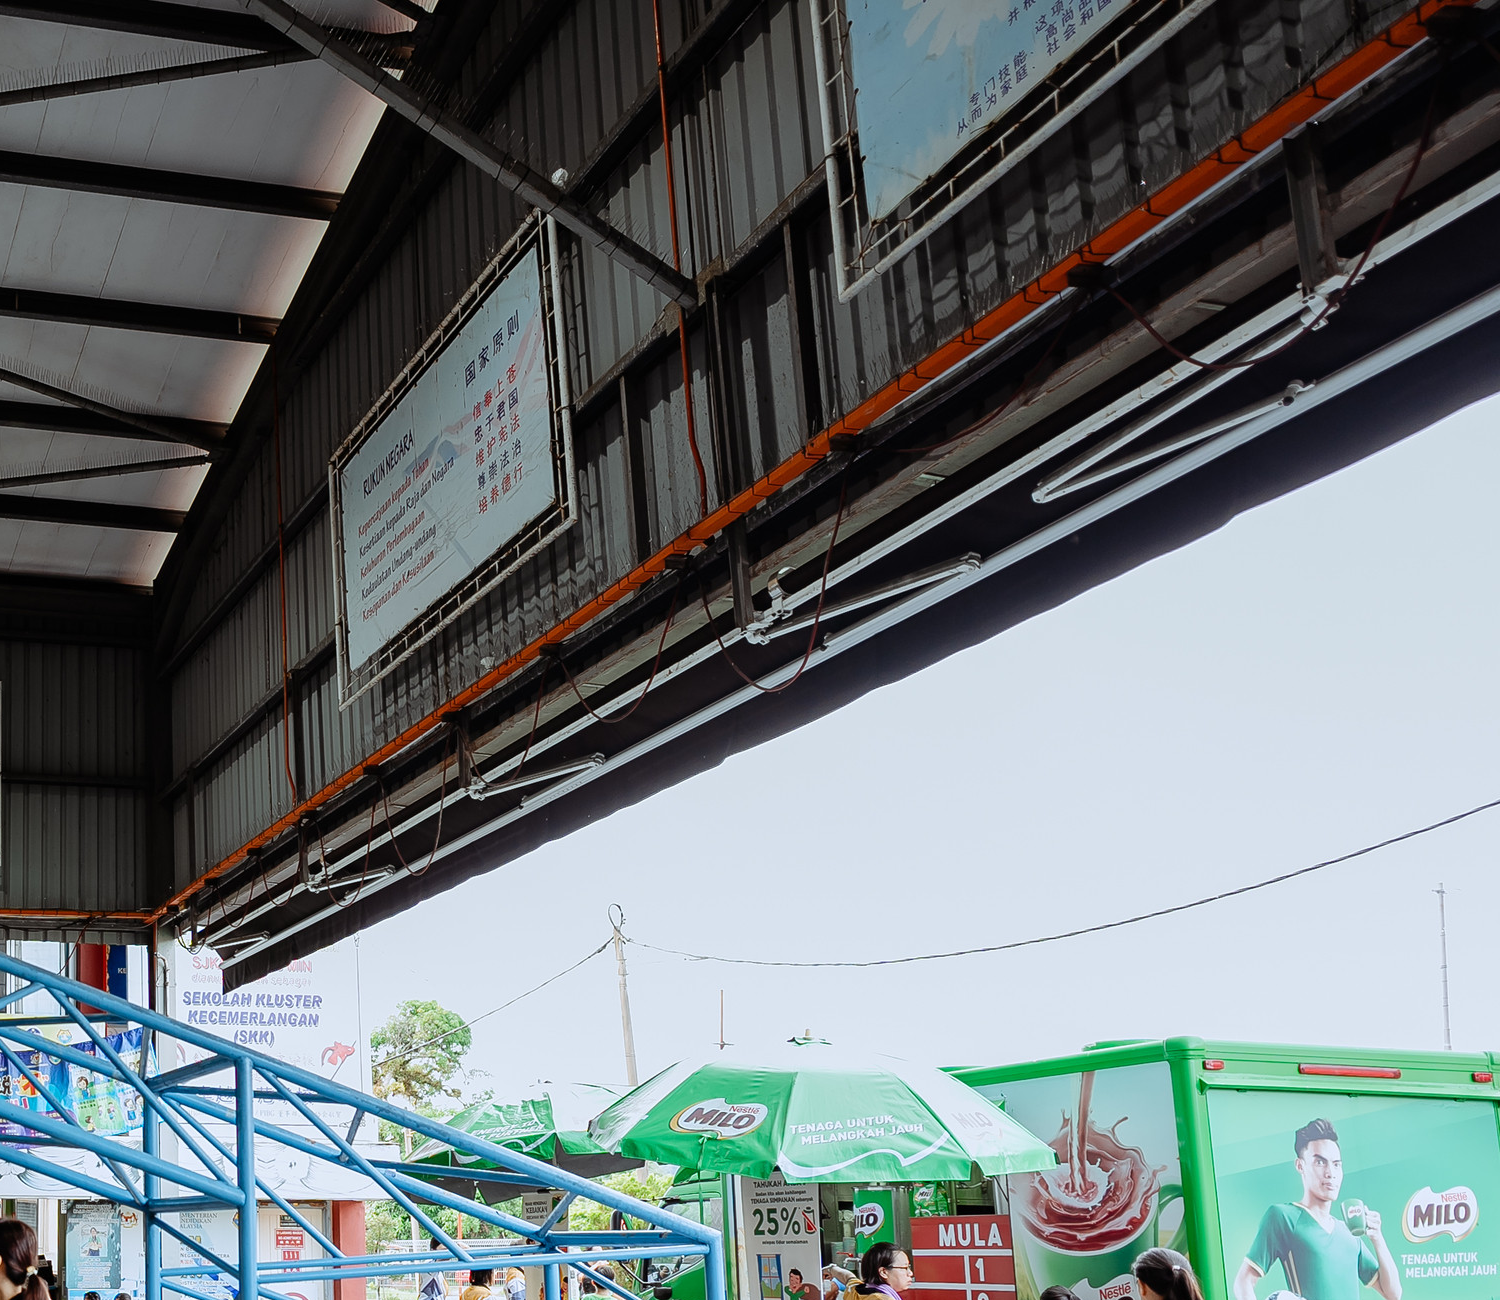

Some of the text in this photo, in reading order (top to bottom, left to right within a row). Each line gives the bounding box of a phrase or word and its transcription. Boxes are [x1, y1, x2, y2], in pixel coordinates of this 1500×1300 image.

[464, 309, 520, 388] 国家原则
[472, 363, 517, 421] 信奉上苍
[473, 387, 519, 445] 忠于君国
[475, 413, 521, 469] 维护宪法
[363, 429, 414, 499] RUKUN NEGARA
[476, 438, 522, 491] 尊崇法治
[358, 458, 429, 538] Kepercayaan kepada Tuhan
[478, 461, 523, 515] 培养德行
[359, 456, 454, 559] Kesetiaan kepada Raja dan Negara
[360, 510, 425, 580] Keluhuran Perlembagaan
[361, 524, 436, 600] Kedaulatan Undang-undang
[362, 550, 435, 622] Kesopanan dan Kesusilaan
[183, 991, 323, 1009] SEKOLAH KLUSTER
[187, 1010, 320, 1028] KECEMERLANGAN
[234, 1030, 275, 1048] (SKK)
[683, 1107, 757, 1130] MILO
[728, 1103, 760, 1115] Nestlé
[790, 1114, 894, 1135] TENAGA UNTUK
[801, 1123, 924, 1145] MELANGKAH JAUH
[753, 1179, 782, 1188] TAHUKAH
[1441, 1191, 1468, 1203] Nestlé
[752, 1207, 801, 1236] 25%
[1413, 1202, 1471, 1228] MILO
[938, 1222, 1002, 1248] MULA
[975, 1257, 985, 1282] 1
[1401, 1252, 1477, 1265] TENAGA UNTUK
[1405, 1264, 1497, 1279] MELANGKAH JAUH
[1100, 1282, 1132, 1300] Nestlé
